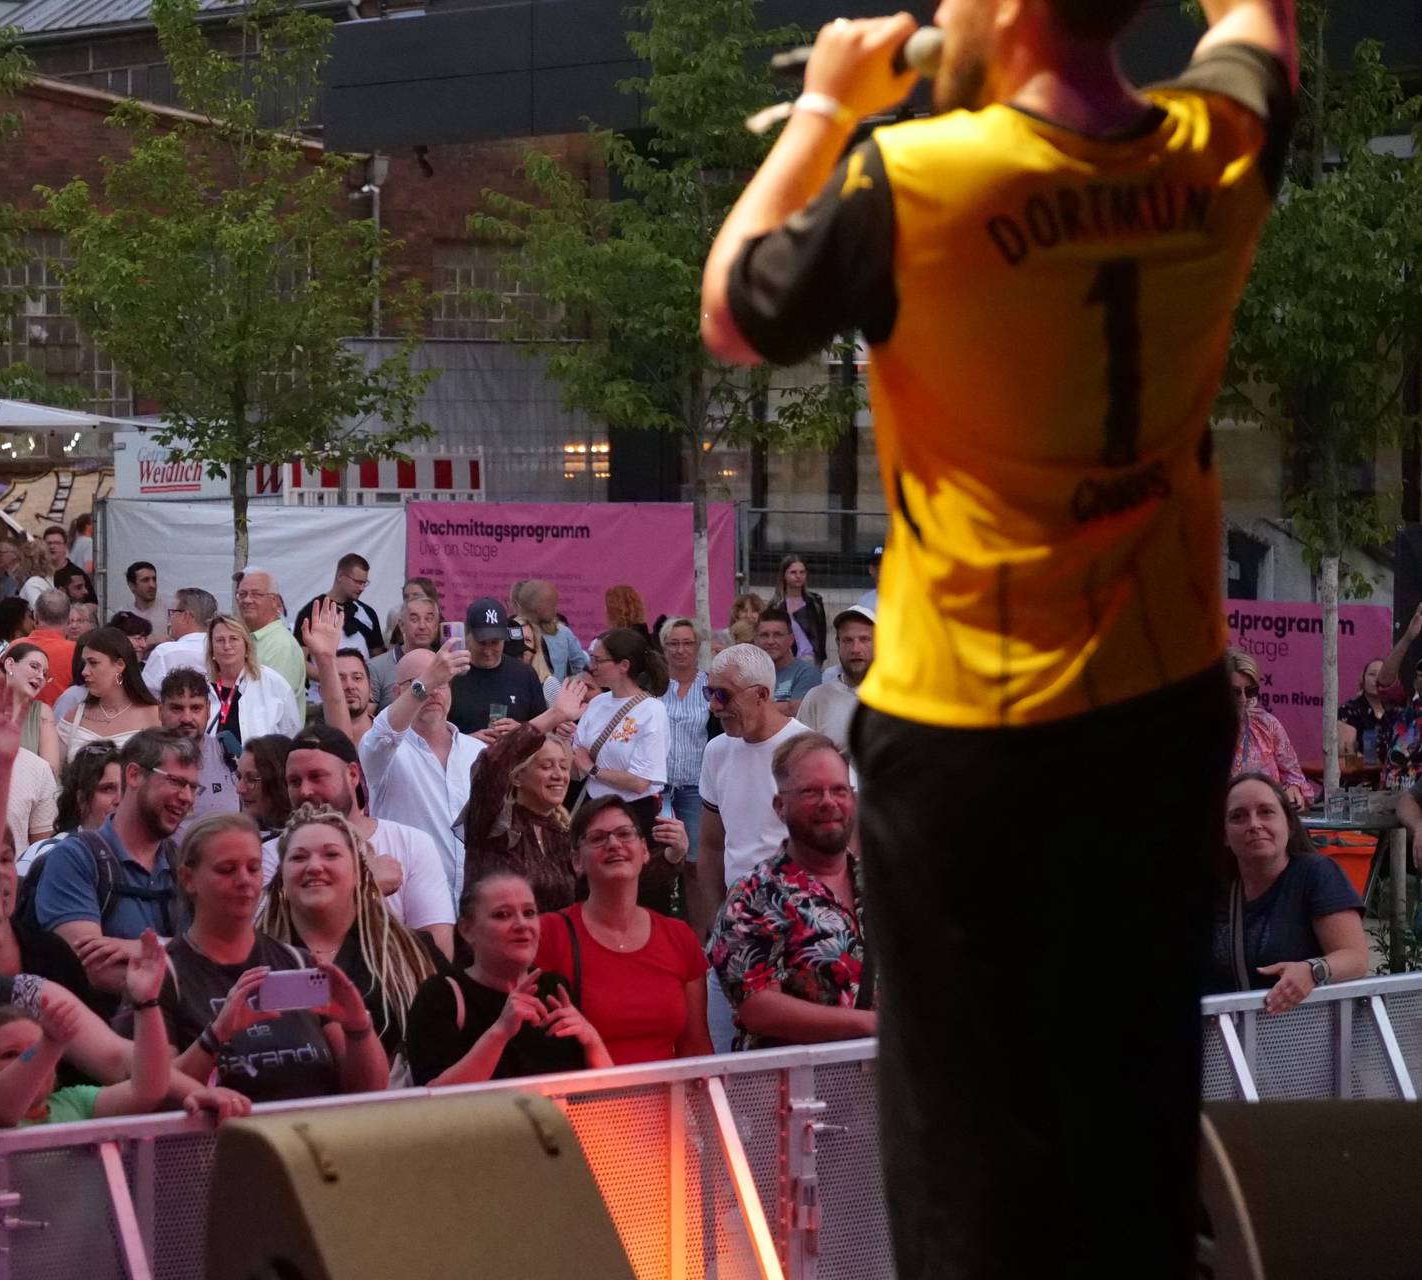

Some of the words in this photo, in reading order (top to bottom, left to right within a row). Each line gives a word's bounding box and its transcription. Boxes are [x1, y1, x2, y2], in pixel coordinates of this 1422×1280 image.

[987, 182, 1212, 266] DORTMUN
[1082, 257, 1142, 467] 1
[139, 459, 203, 484] Weidlich
[419, 518, 590, 543] Nachmittagsprogramm
[419, 543, 439, 557] Live
[443, 545, 459, 557] on
[462, 542, 499, 562] Stage
[1227, 609, 1355, 639] dprogramm
[1239, 636, 1289, 662] Stage
[1272, 693, 1289, 704] on
